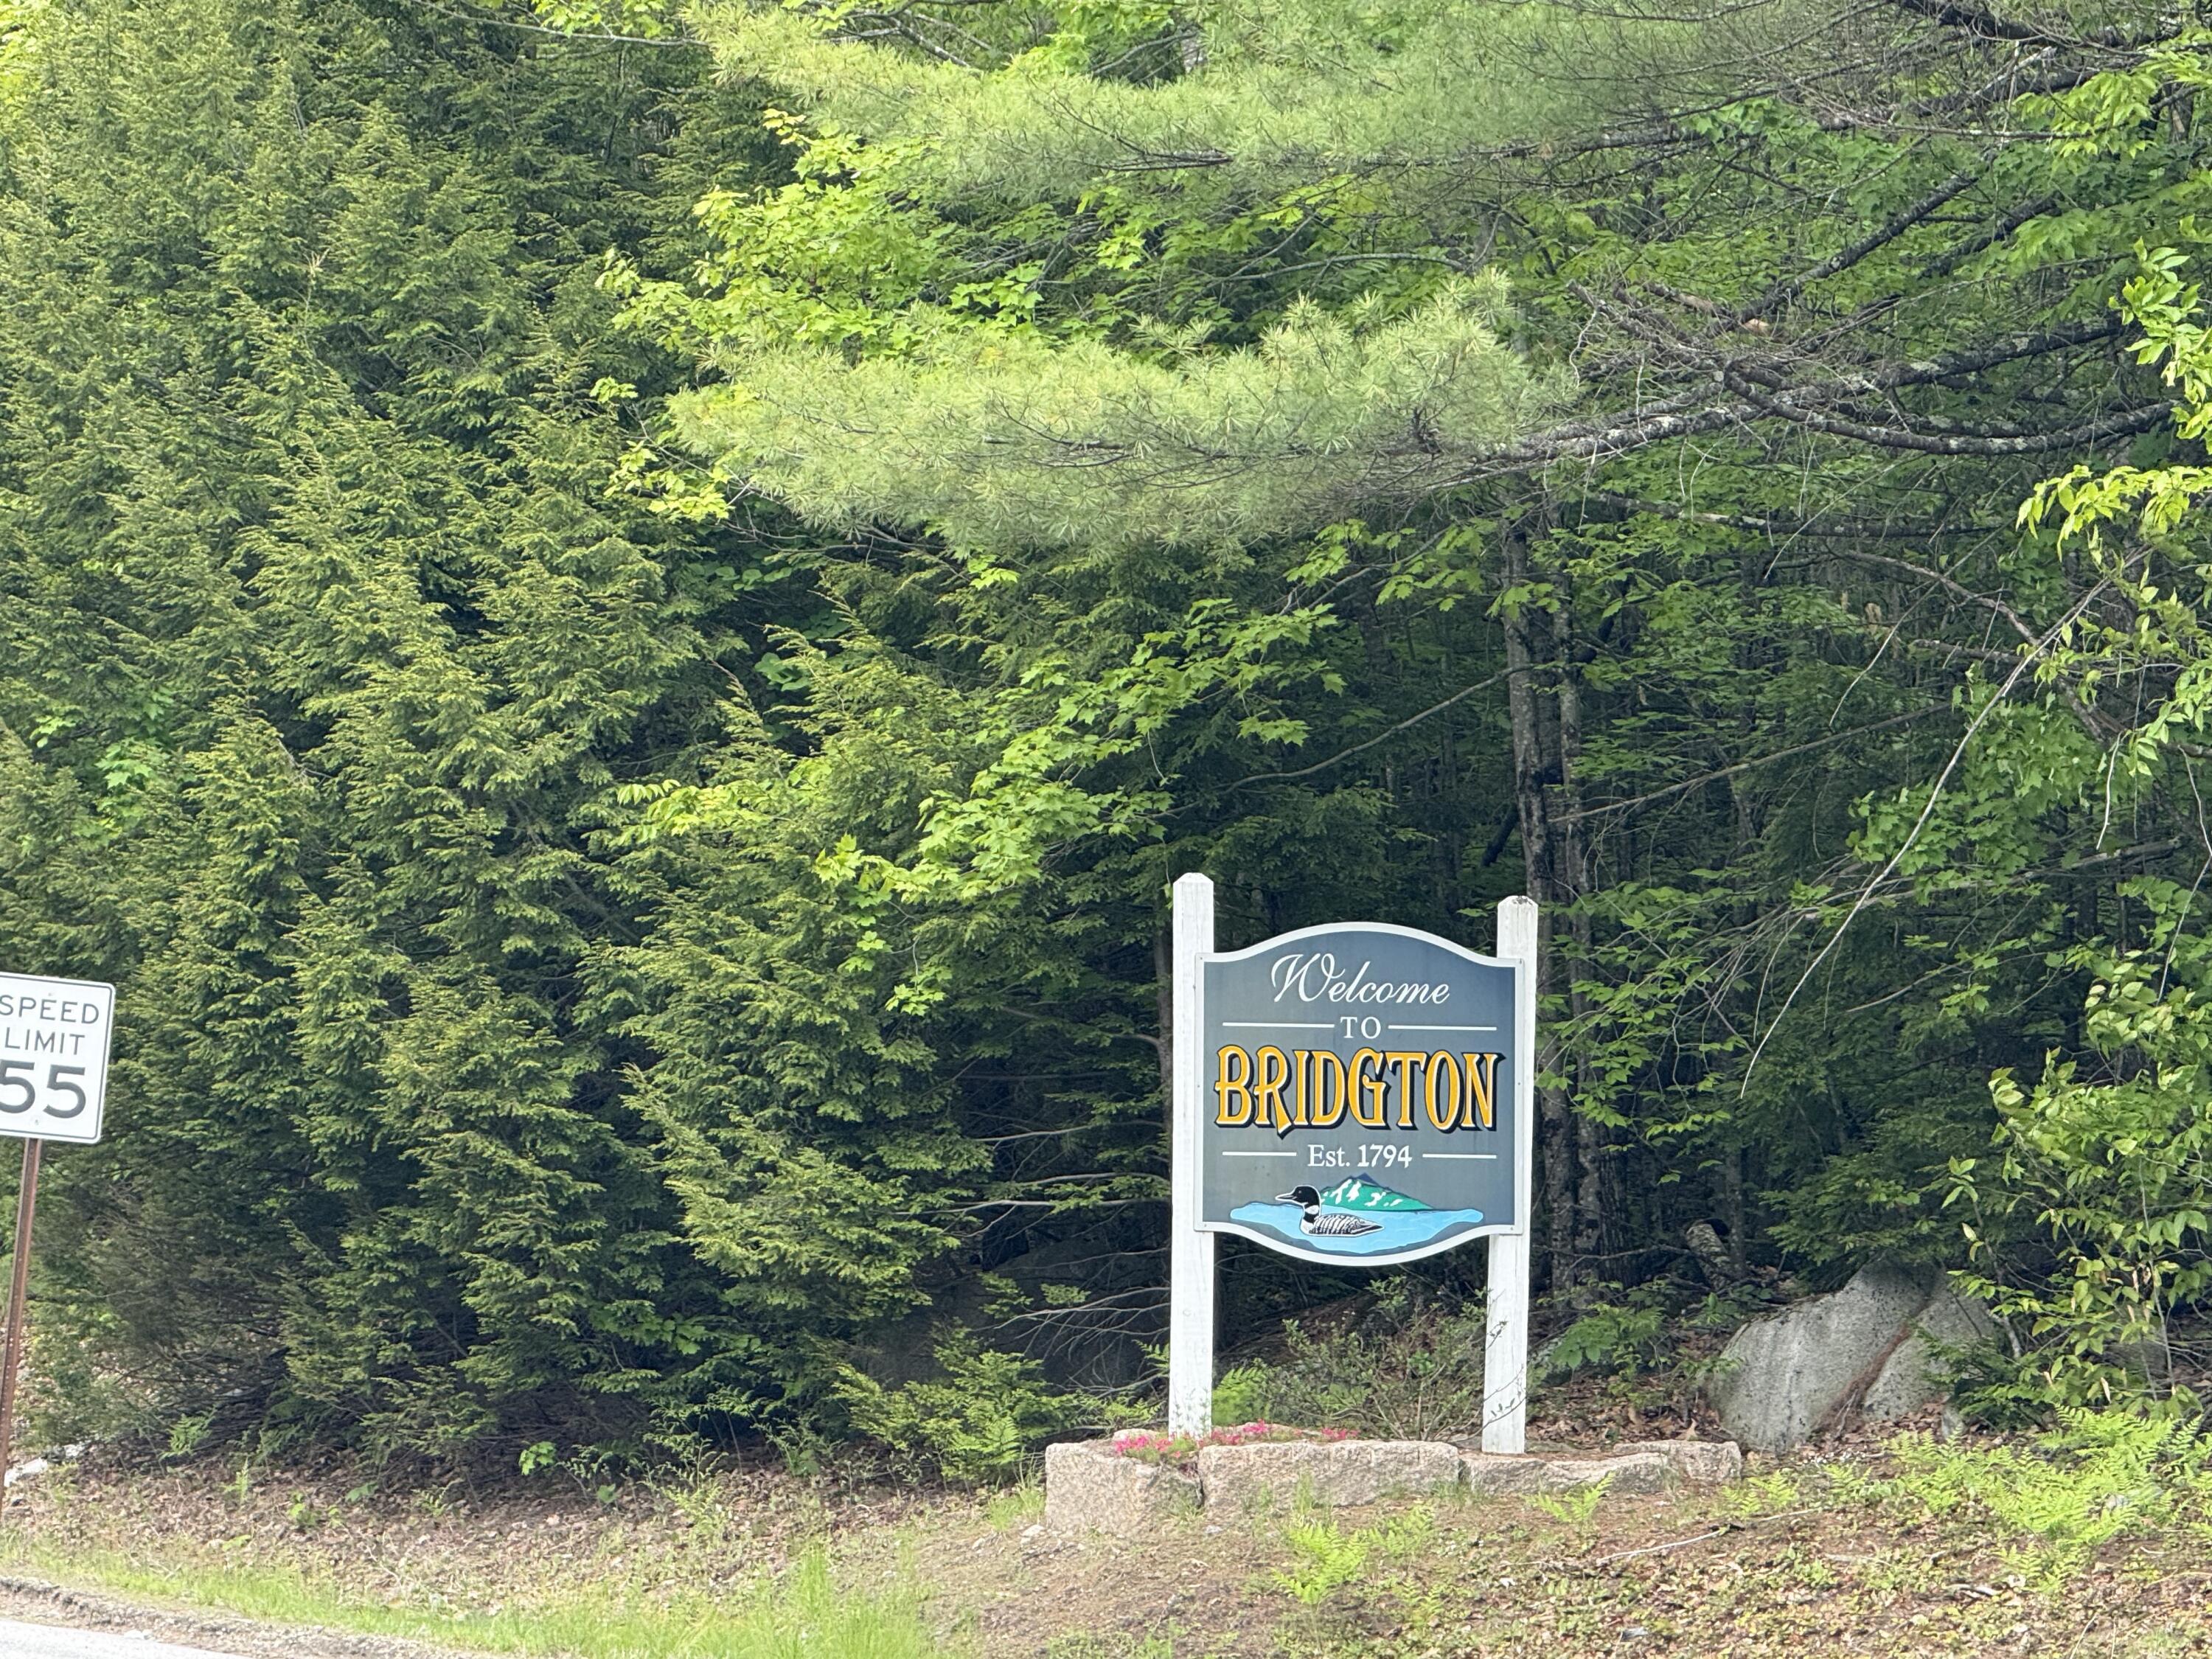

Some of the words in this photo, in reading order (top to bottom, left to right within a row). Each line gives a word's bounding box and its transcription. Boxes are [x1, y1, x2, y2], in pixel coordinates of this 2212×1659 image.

[1270, 952, 1450, 1005] Welcome
[0, 995, 100, 1024] SPEED
[4, 1027, 86, 1055] LIMIT
[1340, 1016, 1382, 1039] TO
[0, 1059, 86, 1119] 55
[1214, 1044, 1505, 1139] BRIDGTON
[1307, 1144, 1351, 1168] Est.
[1357, 1144, 1413, 1169] 1794
